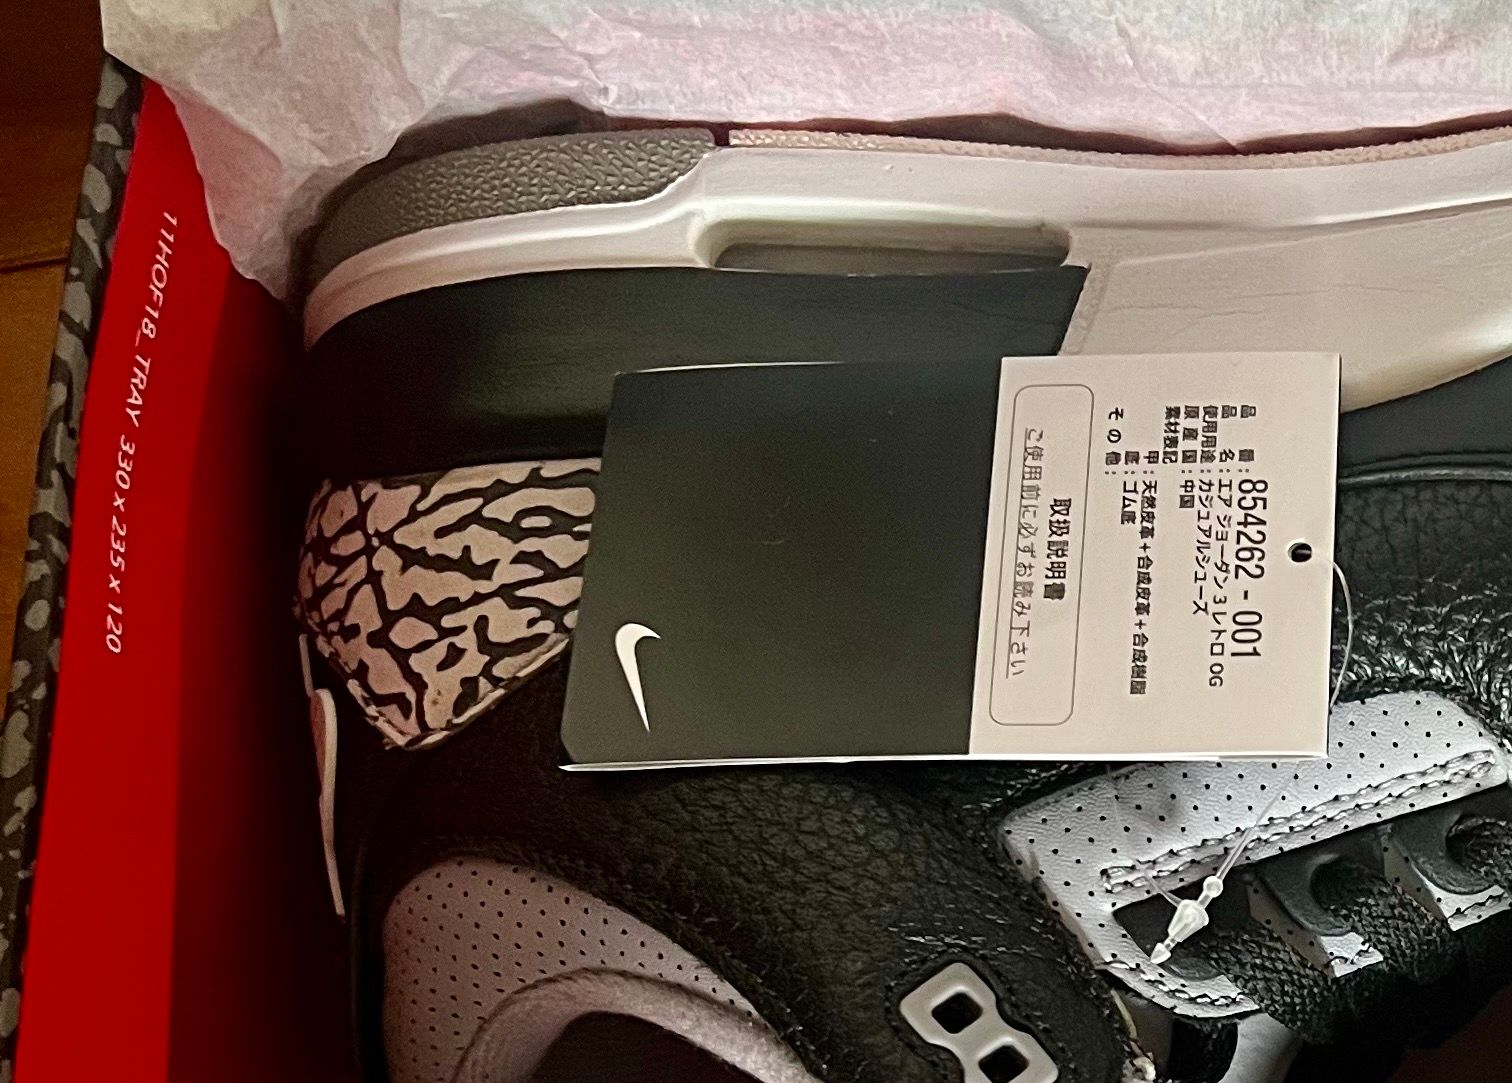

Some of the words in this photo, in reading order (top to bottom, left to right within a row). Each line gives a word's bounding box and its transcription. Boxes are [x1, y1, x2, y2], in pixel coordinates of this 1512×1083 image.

[115, 433, 136, 491] 330
[112, 491, 126, 511] x
[109, 515, 127, 572] 235
[1009, 427, 1044, 678] ご使用前に必ずお読み下さい
[1043, 497, 1072, 601] 取扱説明書
[1234, 478, 1269, 580] 854262
[107, 573, 121, 593] x
[105, 602, 123, 654] 120
[1230, 610, 1263, 659] 001
[1208, 662, 1225, 688] OG
